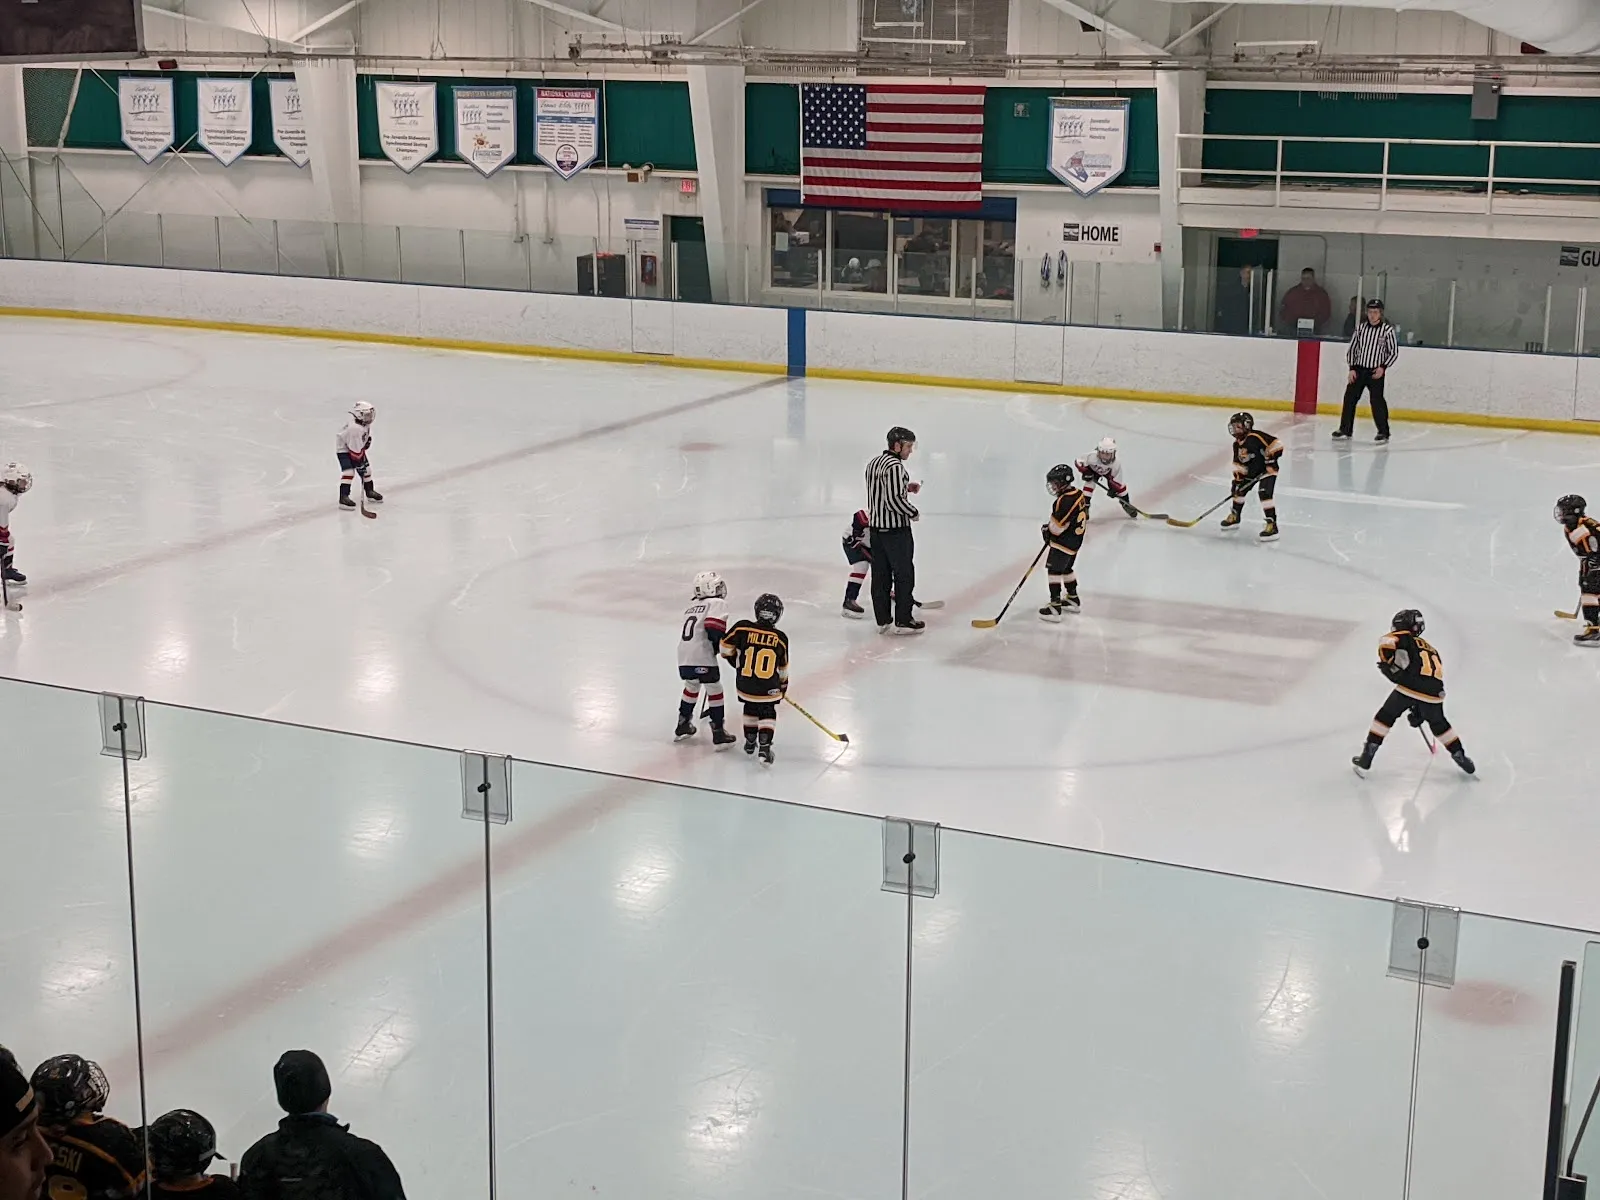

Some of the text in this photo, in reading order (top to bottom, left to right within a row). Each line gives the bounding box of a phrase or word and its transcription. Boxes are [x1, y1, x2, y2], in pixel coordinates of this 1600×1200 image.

[1081, 225, 1119, 242] HOME
[1581, 250, 1600, 267] GU
[747, 632, 779, 648] MILLER
[741, 646, 777, 680] 10
[1419, 649, 1443, 681] 11
